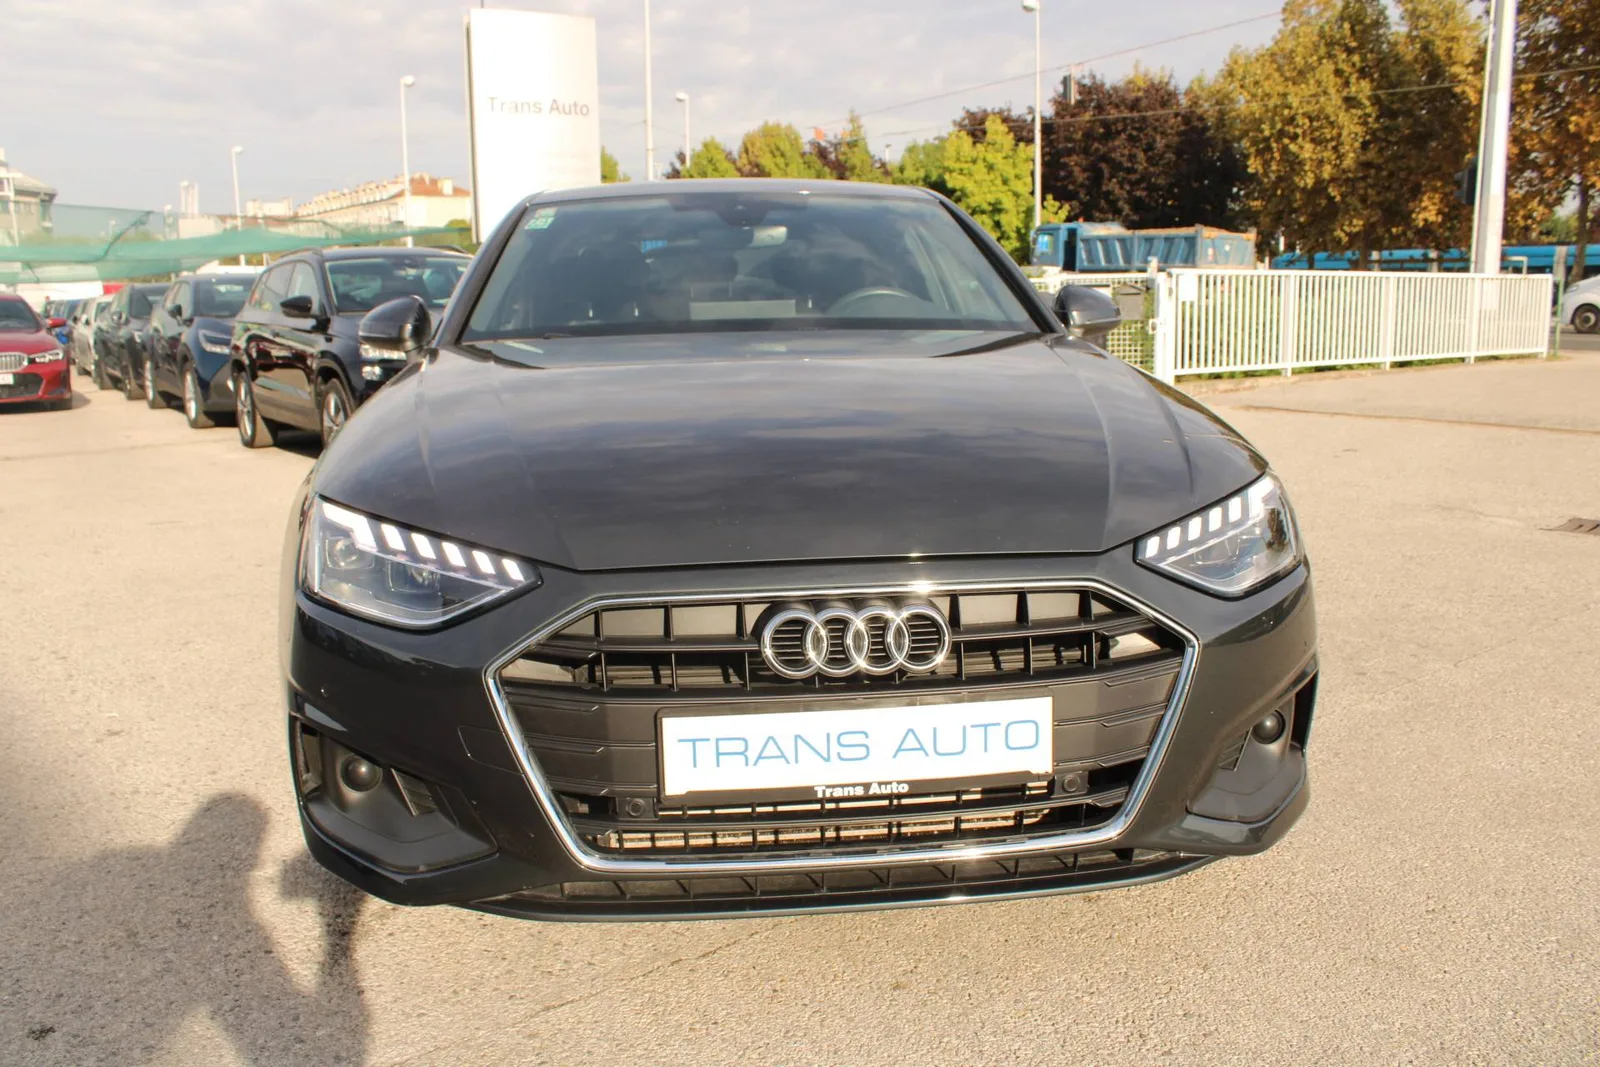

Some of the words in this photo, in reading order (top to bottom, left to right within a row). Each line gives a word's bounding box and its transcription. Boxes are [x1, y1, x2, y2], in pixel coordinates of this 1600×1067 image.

[487, 97, 542, 114] Trans
[549, 98, 589, 116] Auto
[677, 730, 870, 768] TRANS
[892, 720, 1039, 759] AUTO
[814, 785, 865, 798] Trans
[868, 781, 909, 795] Auto
